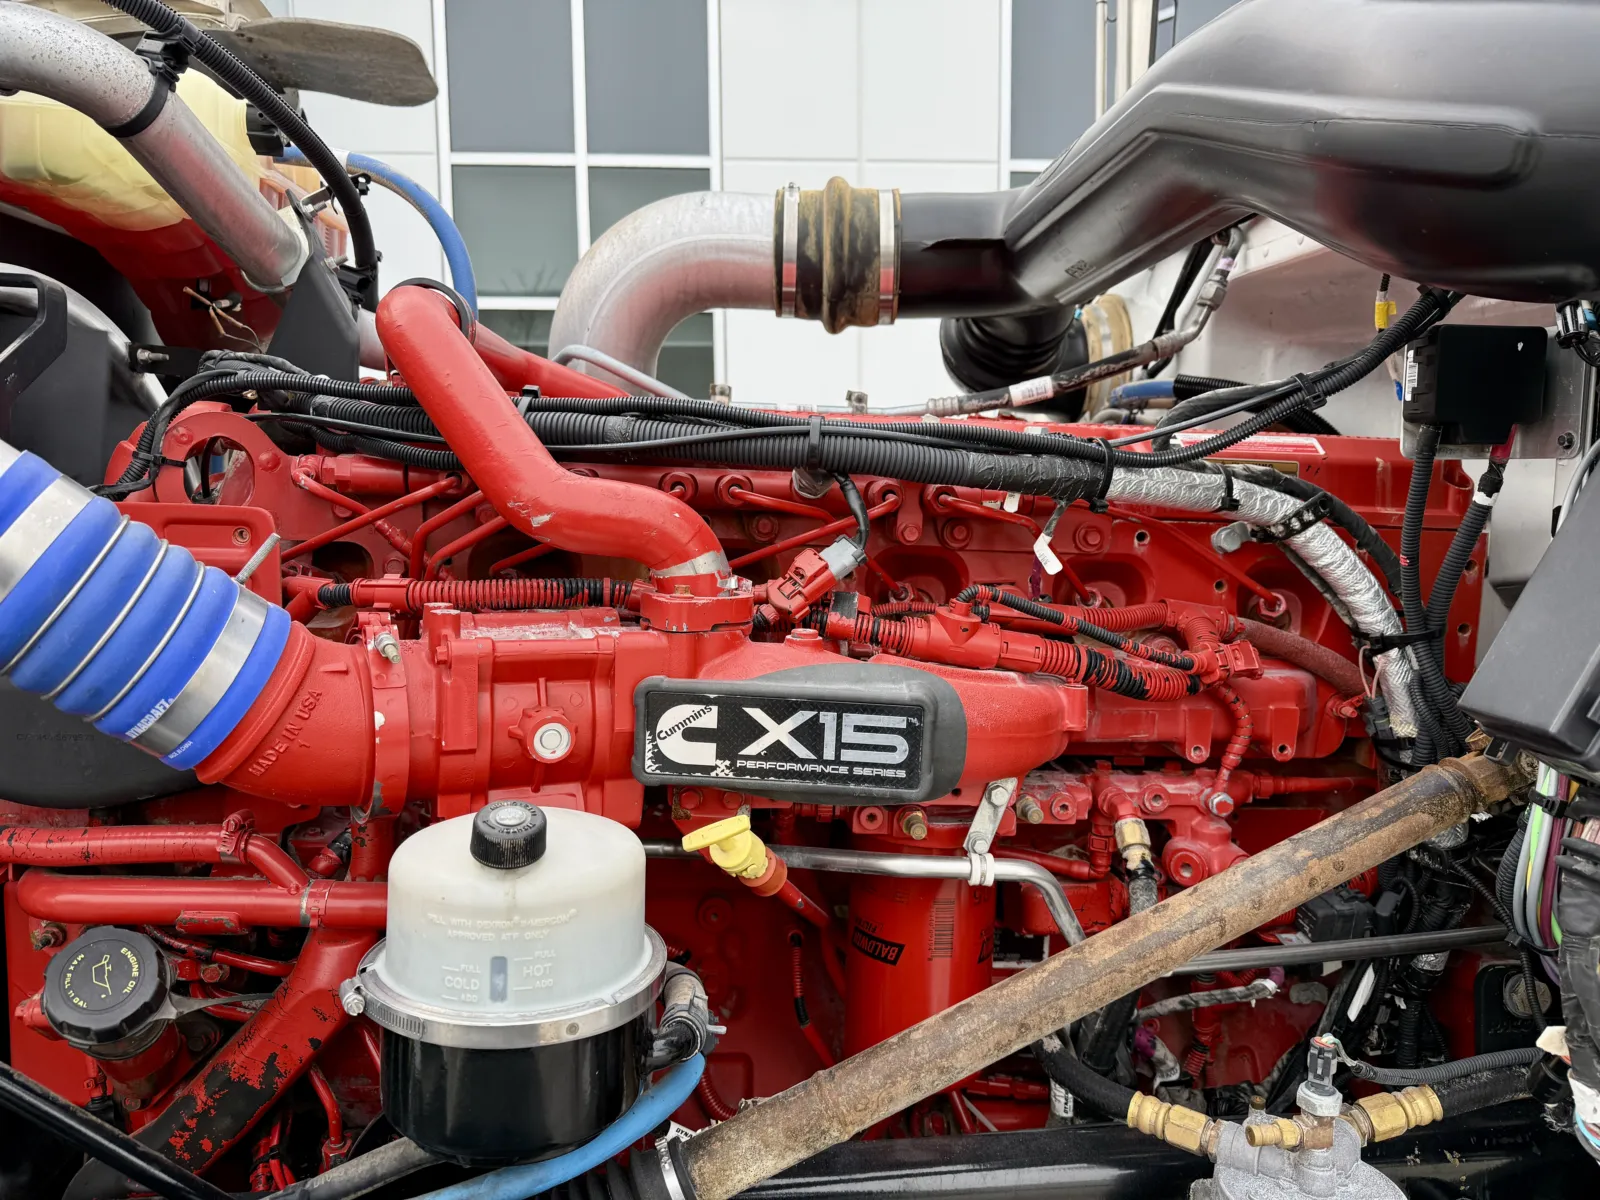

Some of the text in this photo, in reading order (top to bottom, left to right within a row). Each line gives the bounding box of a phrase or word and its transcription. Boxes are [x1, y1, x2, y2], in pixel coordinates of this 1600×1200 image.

[656, 703, 713, 741] Cummins
[248, 691, 322, 777] MADE IN USA
[737, 760, 906, 778] PERFORMANCE SERIES
[450, 916, 472, 928] WITH
[448, 929, 550, 941] APPROVED ATF ONLY
[852, 931, 899, 961] BALDWIN
[534, 949, 556, 958] FULL
[120, 947, 139, 994] ENGINE OIL
[460, 964, 481, 974] FULL
[523, 963, 553, 977] HOT
[64, 953, 88, 1009] MAX FILL 11 GAL
[445, 976, 480, 990] COLD
[535, 979, 553, 988] ADD
[461, 993, 478, 1003] ADD
